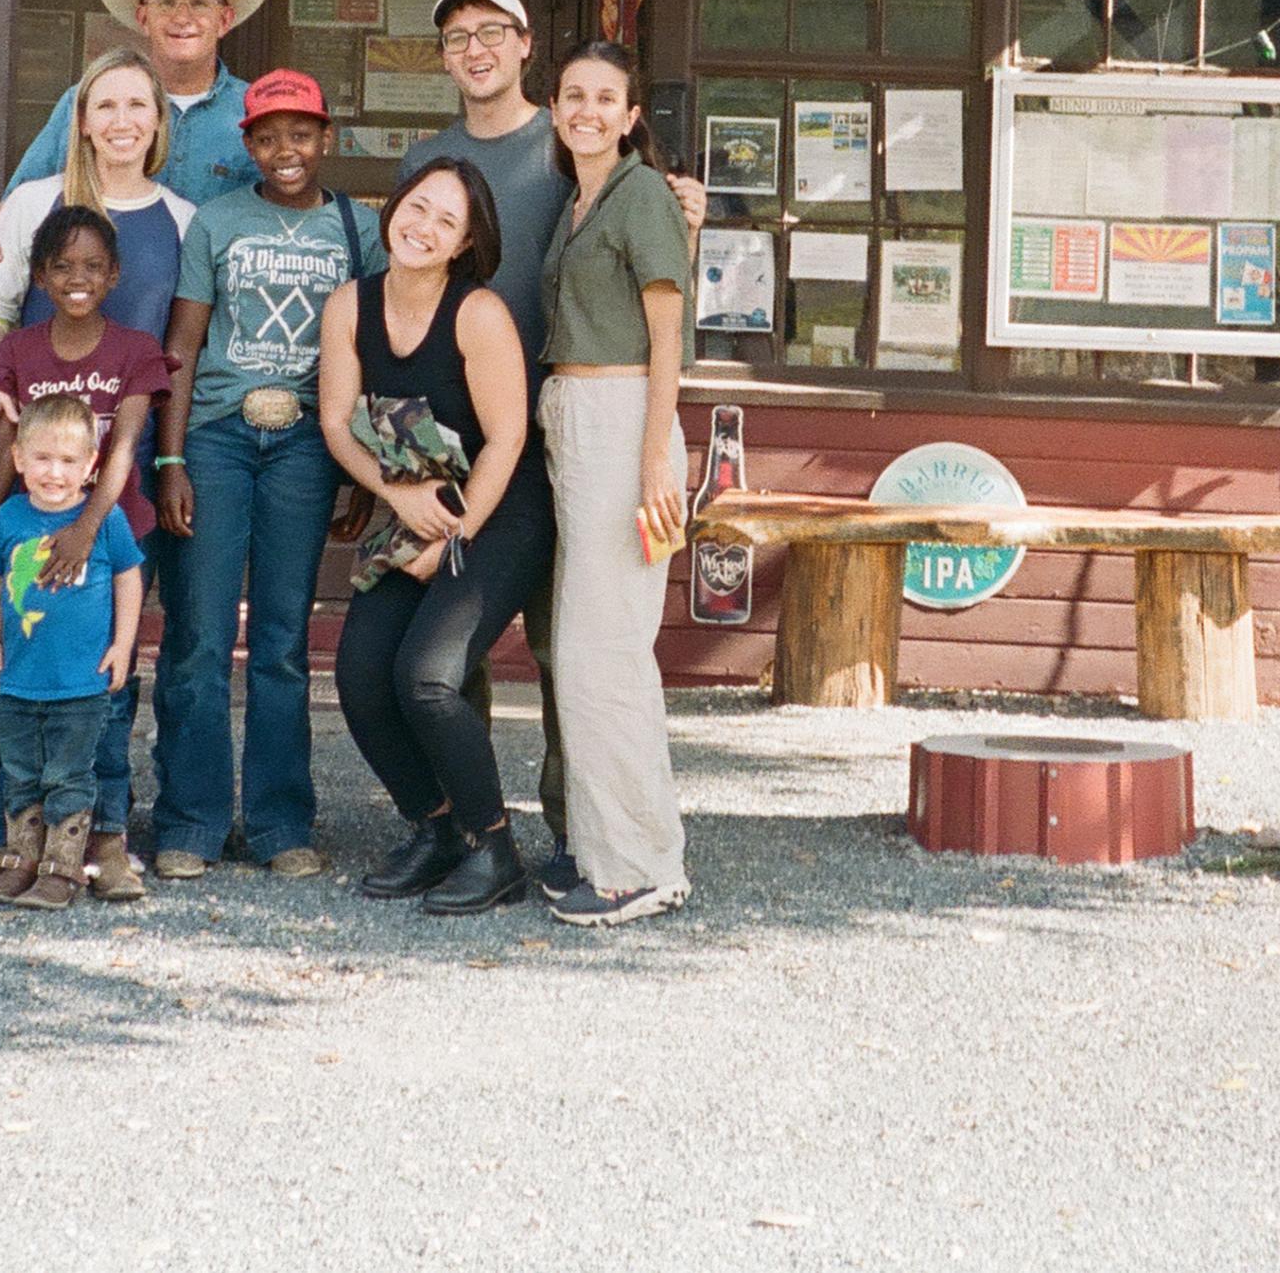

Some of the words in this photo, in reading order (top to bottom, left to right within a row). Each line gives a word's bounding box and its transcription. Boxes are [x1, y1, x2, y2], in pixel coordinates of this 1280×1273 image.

[256, 248, 338, 279] Diamond
[269, 269, 310, 286] Ranch
[27, 374, 85, 401] Stand
[86, 371, 121, 395] Out
[923, 556, 974, 590] IPA
